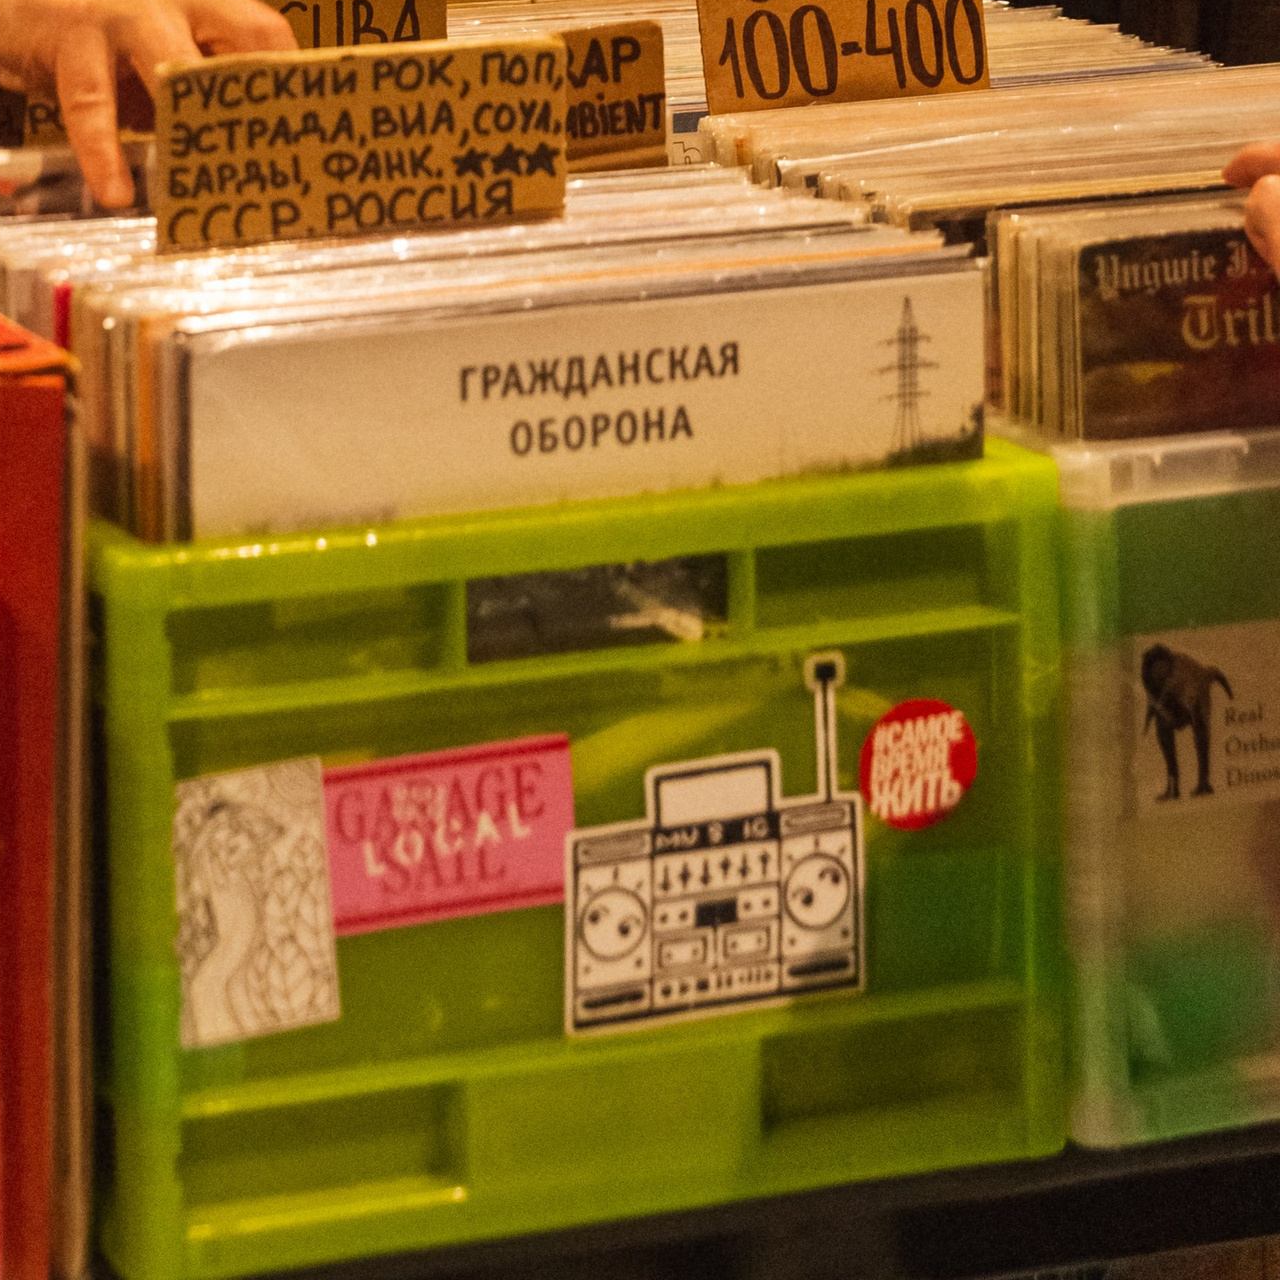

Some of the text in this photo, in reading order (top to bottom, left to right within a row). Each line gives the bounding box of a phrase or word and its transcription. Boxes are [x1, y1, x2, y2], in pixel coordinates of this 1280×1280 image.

[170, 50, 563, 114] РУССКИЙ РОК, ПОП,
[170, 109, 366, 159] ЭСТРАДА,
[370, 99, 470, 147] ВИА,
[168, 154, 312, 200] БАРДЫ,
[326, 178, 516, 232] РОССИЯ
[1181, 292, 1280, 350] Tril
[459, 340, 741, 404] ГРАЖДАНСКАЯ
[507, 403, 696, 458] ОБОРОНА
[871, 769, 962, 819] ЖИТЬ
